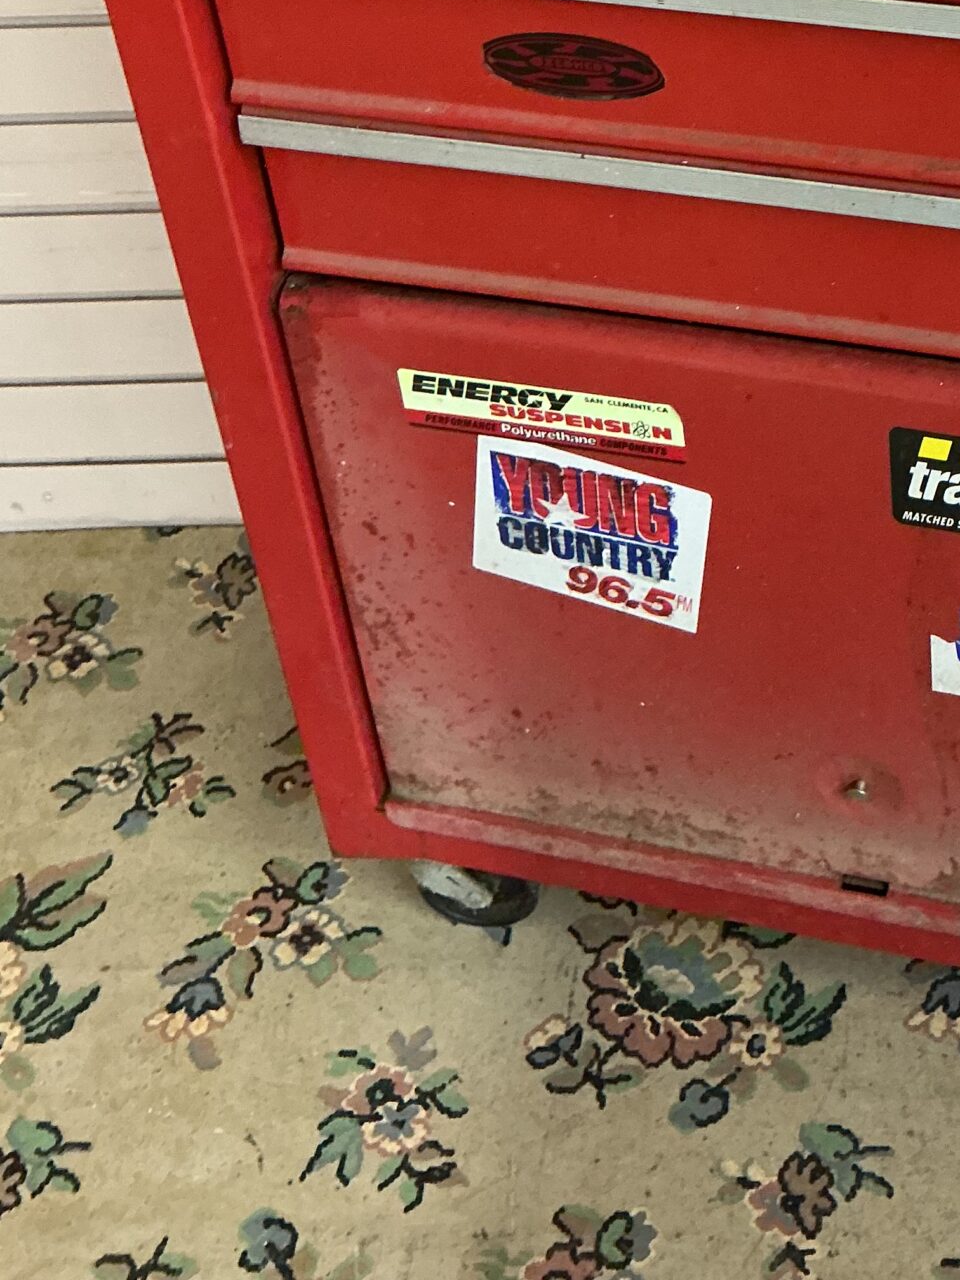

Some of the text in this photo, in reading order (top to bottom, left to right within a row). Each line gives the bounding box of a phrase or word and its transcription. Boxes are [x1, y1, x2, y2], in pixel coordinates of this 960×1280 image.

[412, 373, 573, 411] ENERGY
[584, 397, 604, 405] SAN
[424, 413, 667, 456] PERFORMANCE Polyurethane COMPONENTS
[494, 453, 672, 546] YOUNG
[902, 510, 954, 528] MATCHED
[498, 516, 678, 581] COUNTRY
[565, 565, 677, 618] 96.5
